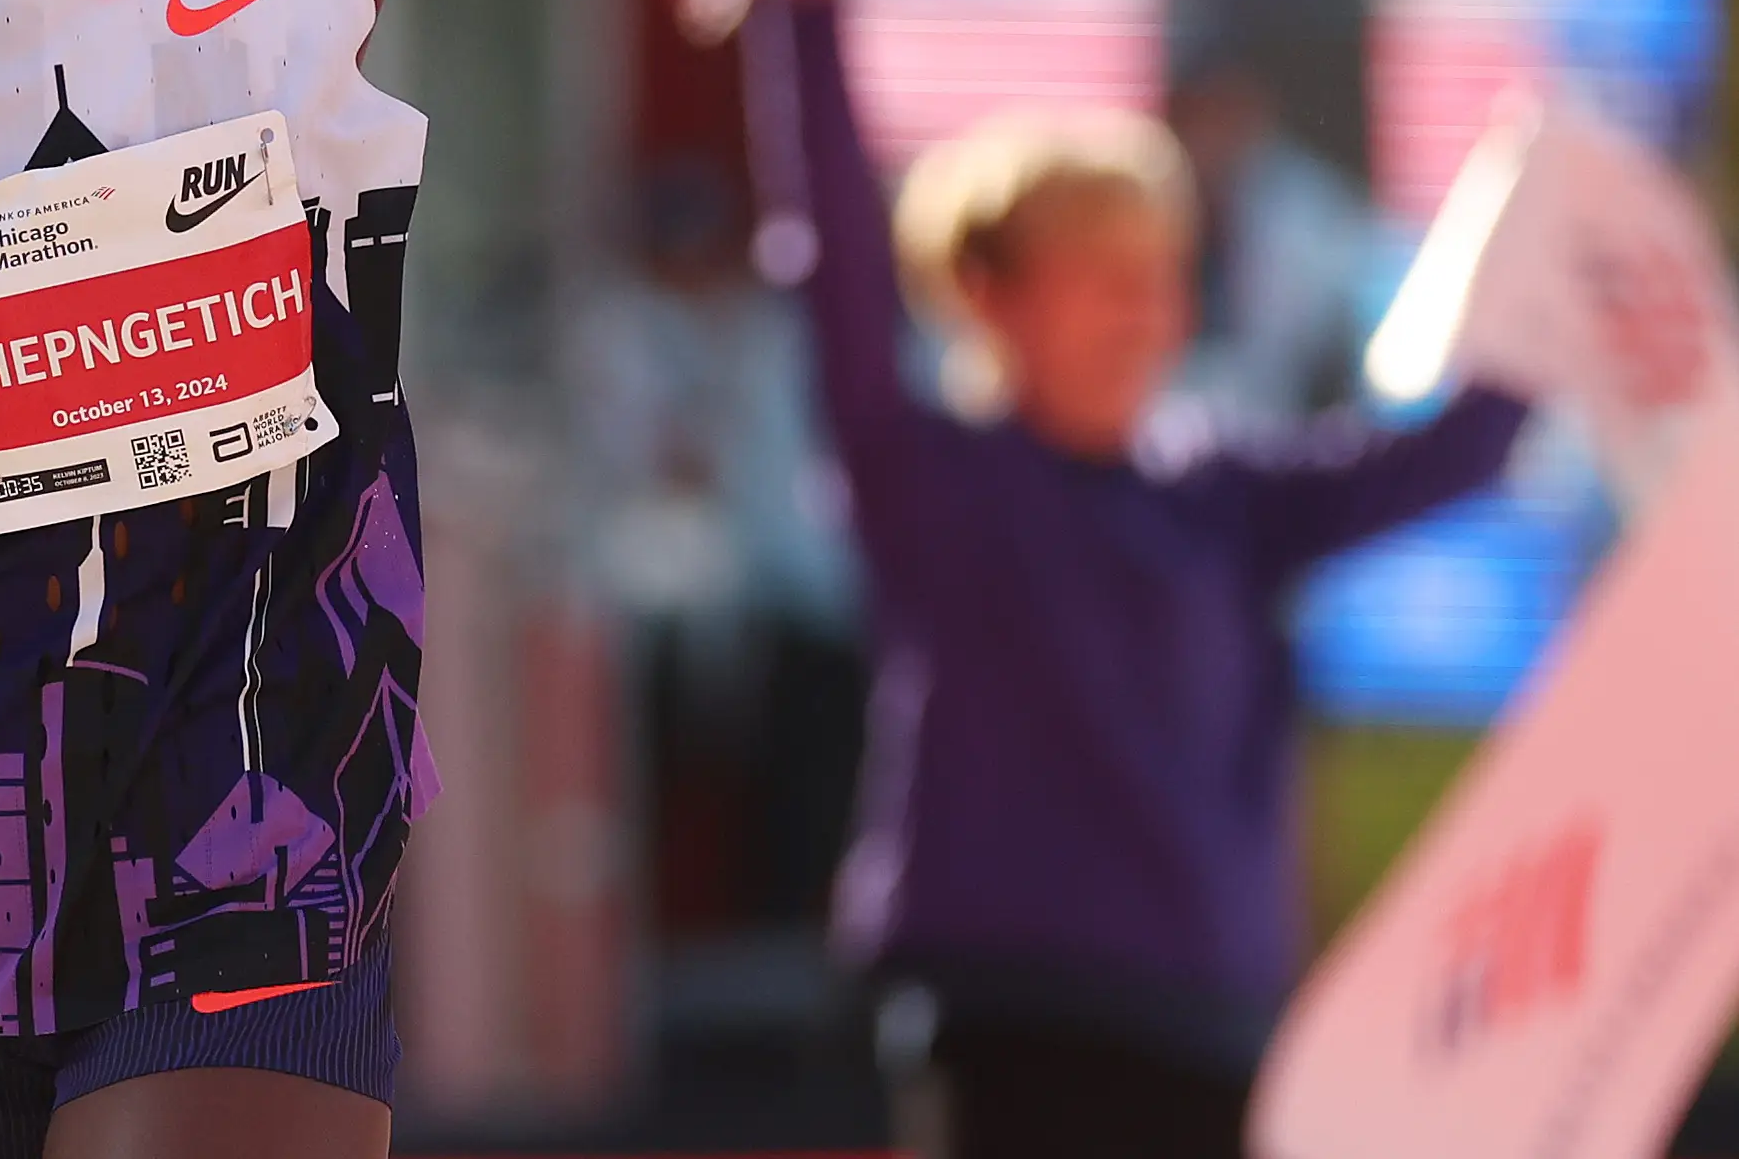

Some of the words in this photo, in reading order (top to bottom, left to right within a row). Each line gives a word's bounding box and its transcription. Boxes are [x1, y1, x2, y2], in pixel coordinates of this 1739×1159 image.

[180, 153, 247, 203] RUN
[17, 208, 32, 219] OF
[34, 196, 90, 216] AMERICA
[52, 398, 134, 428] October
[138, 387, 173, 408] 13,
[174, 373, 229, 401] 2024
[253, 405, 287, 424] ABBOTT
[254, 414, 284, 432] WORLD
